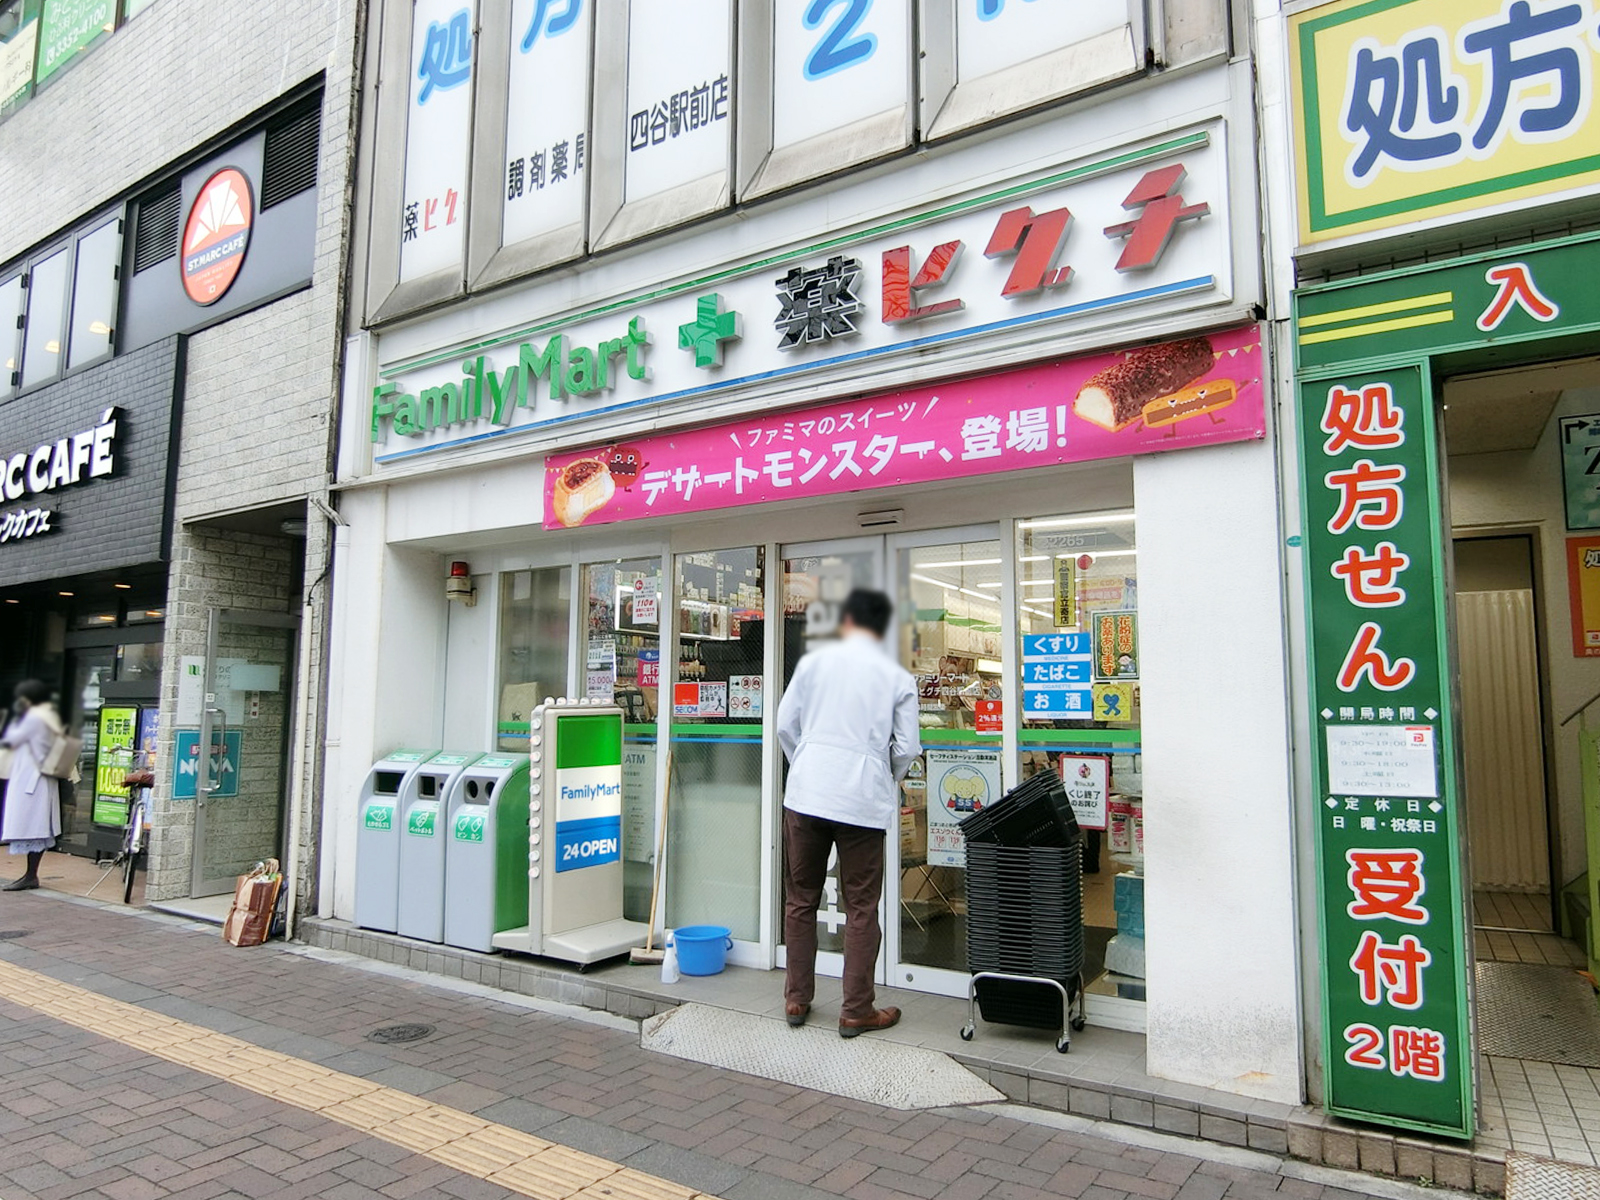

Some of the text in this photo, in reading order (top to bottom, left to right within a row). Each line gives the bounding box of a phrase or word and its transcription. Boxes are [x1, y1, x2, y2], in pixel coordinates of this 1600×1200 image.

[630, 72, 728, 152] 四谷駅前店
[1341, 0, 1600, 183] 処方
[1476, 263, 1560, 333] 入
[371, 314, 653, 444] FamilyMart
[747, 401, 918, 449] ファミマのスイーツ
[29, 406, 117, 493] CAFÉ
[0, 507, 51, 543] クカフェ
[1319, 381, 1416, 693] 処方せん
[1034, 635, 1079, 653] くすり
[1034, 665, 1080, 681] たばこ
[675, 706, 698, 714] SECOM
[1339, 706, 1415, 721] 開局時間
[180, 758, 234, 776] NVA
[625, 754, 646, 764] ATM
[561, 783, 621, 801] FamilyMart
[1068, 789, 1101, 800] くじ終了
[1345, 848, 1432, 1010] 受付
[1344, 1025, 1446, 1082] 2階
